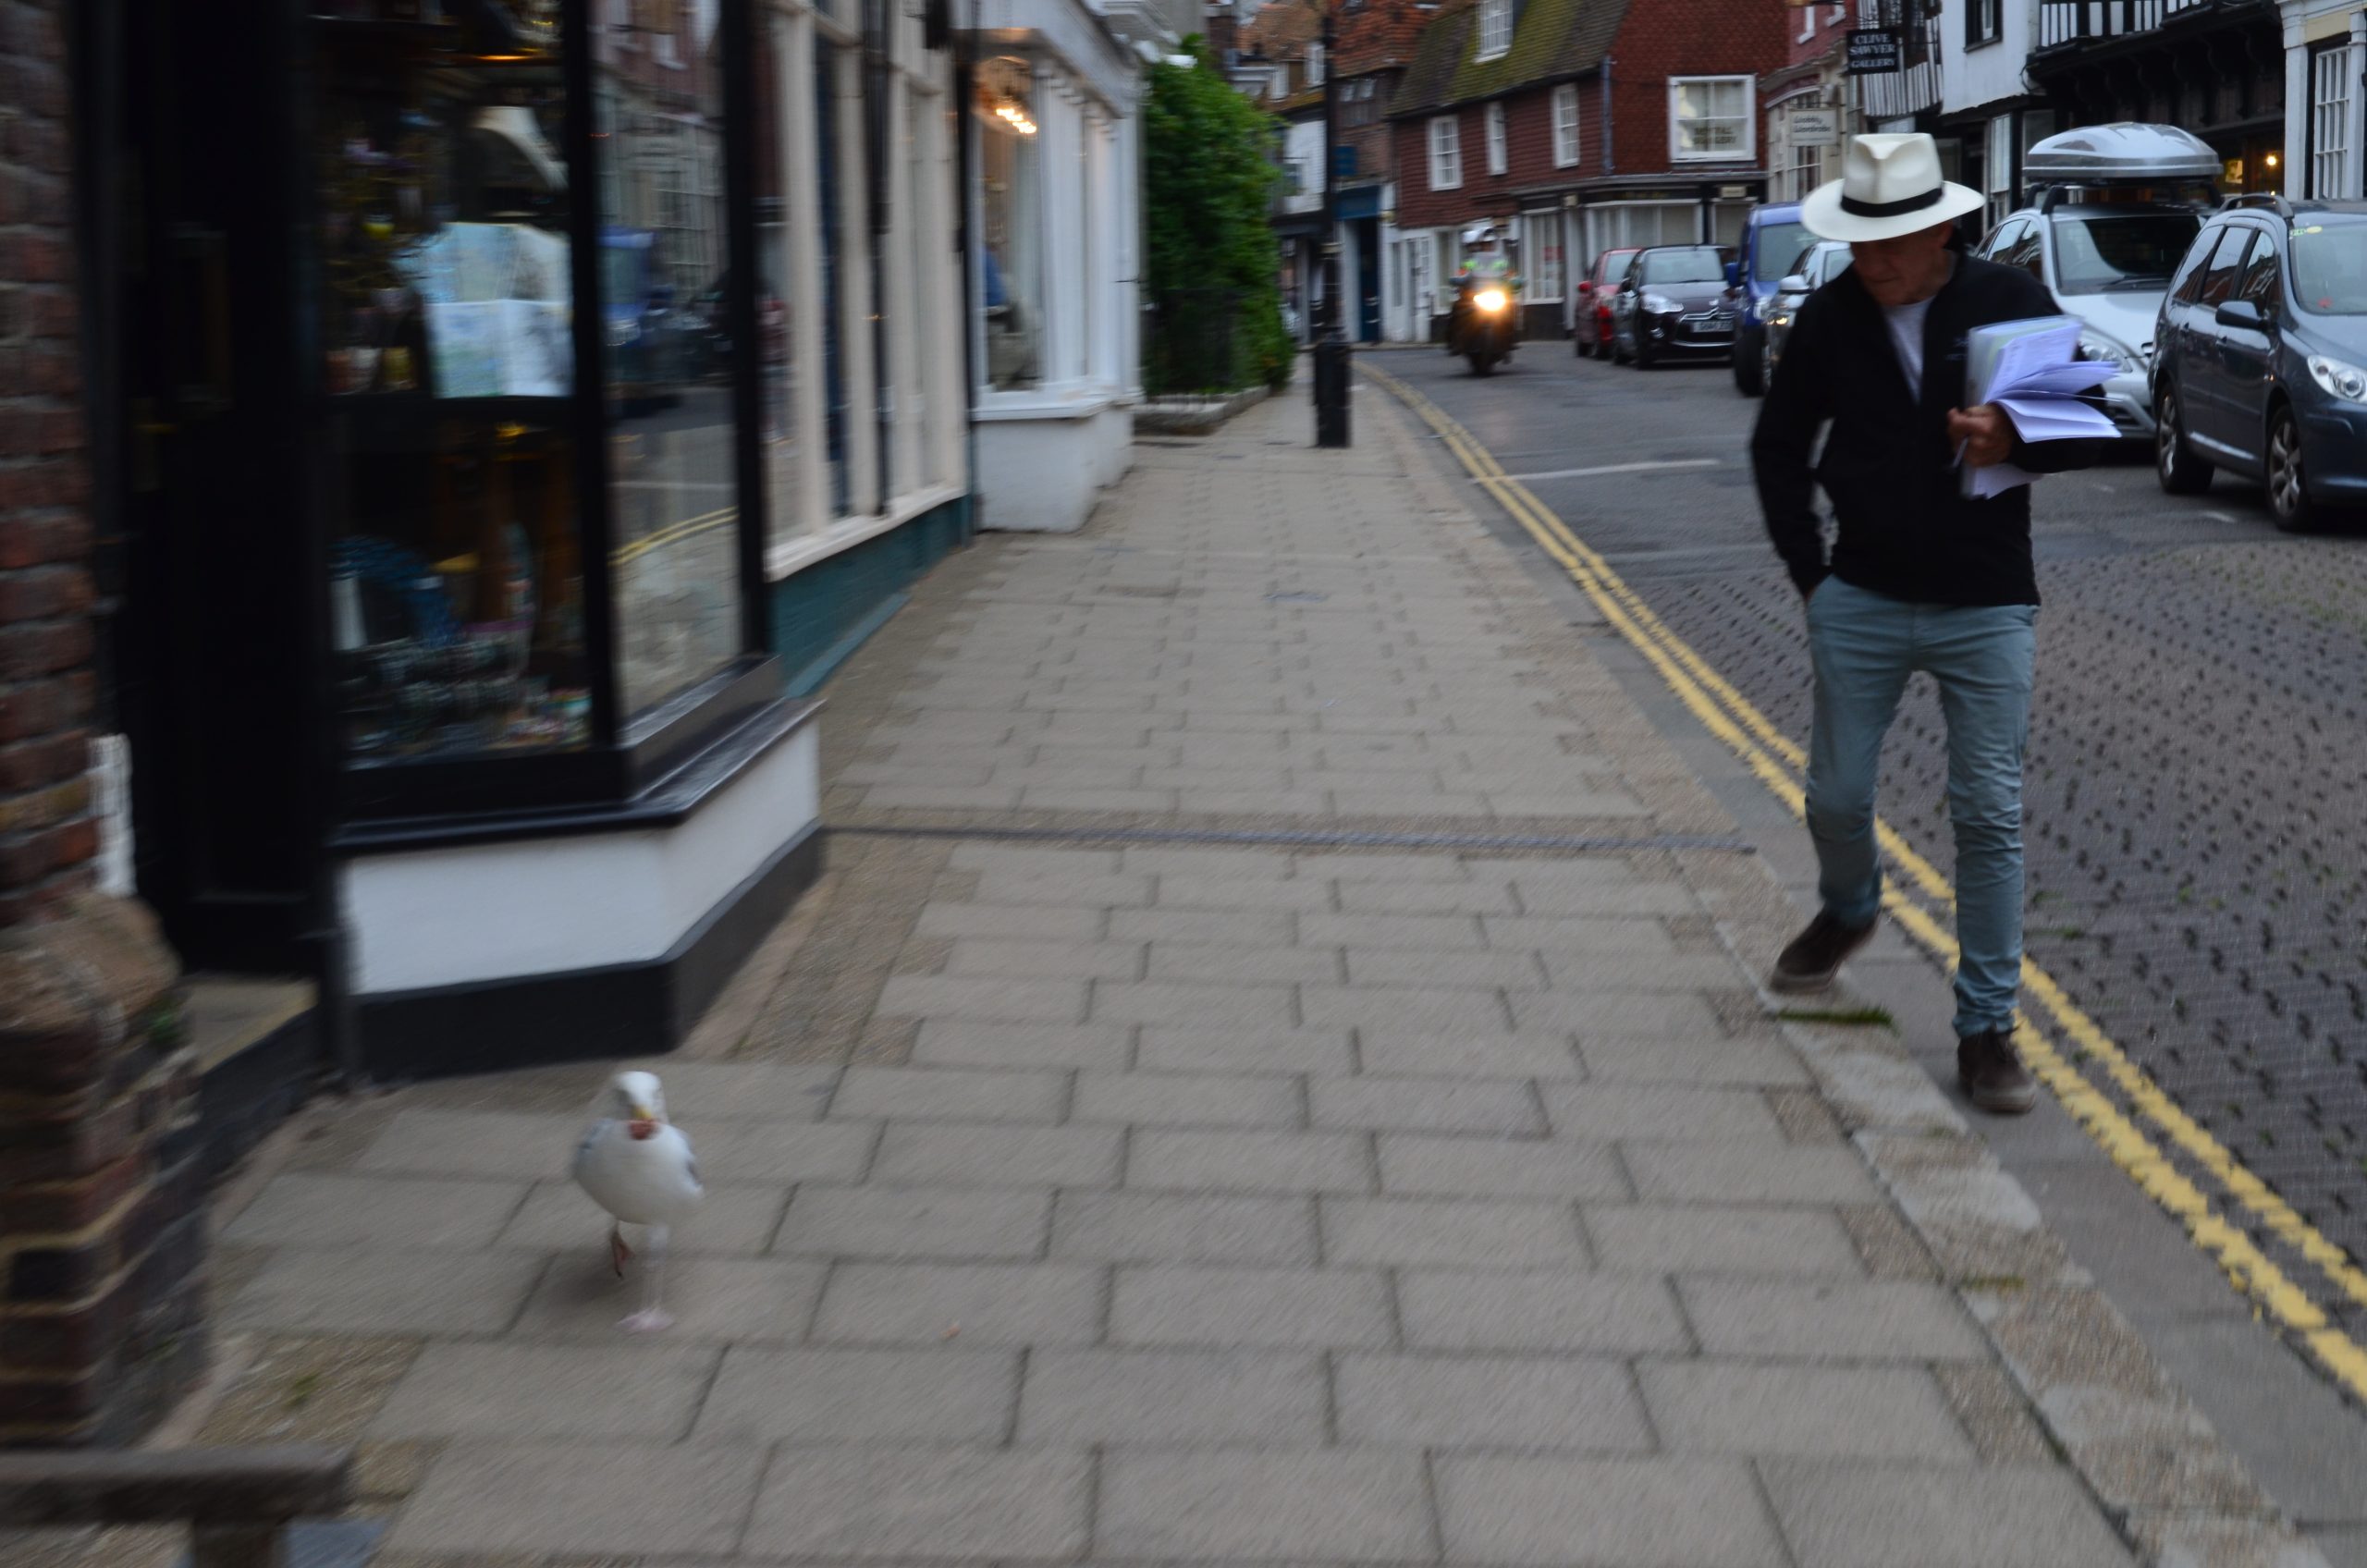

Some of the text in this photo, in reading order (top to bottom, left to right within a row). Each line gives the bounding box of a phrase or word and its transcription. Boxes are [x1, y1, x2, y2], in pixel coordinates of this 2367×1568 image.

[1854, 33, 1892, 44] CLIVE
[1849, 43, 1895, 55] SAWYER
[1851, 58, 1895, 68] GALLERY
